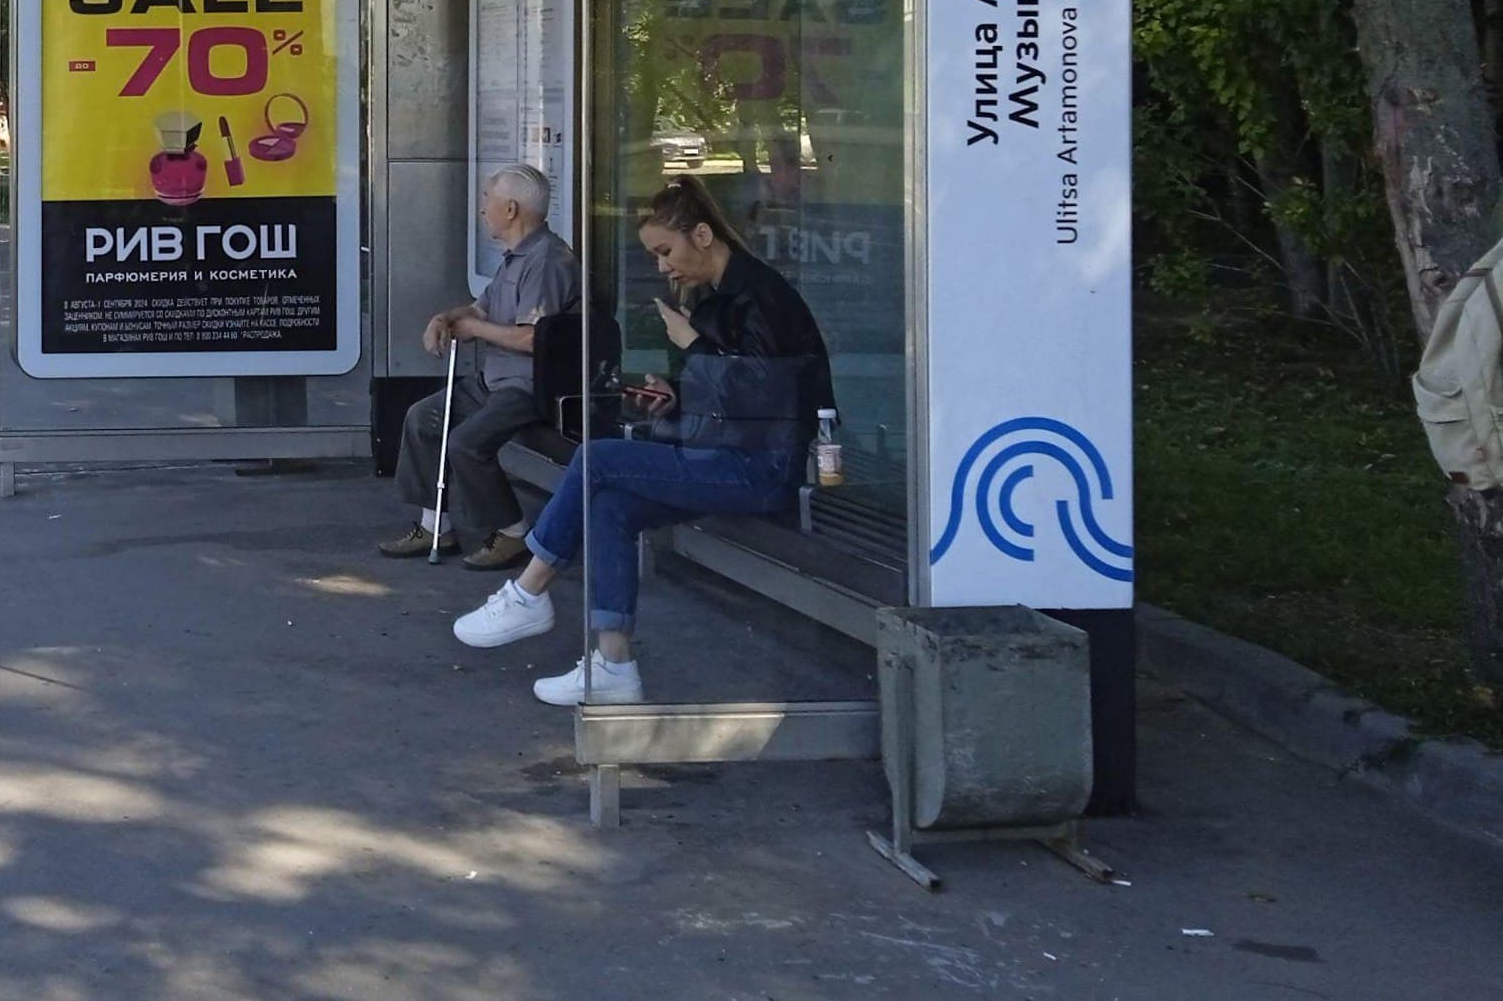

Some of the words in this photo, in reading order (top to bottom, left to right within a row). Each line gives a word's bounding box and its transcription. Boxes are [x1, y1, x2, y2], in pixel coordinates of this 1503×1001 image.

[967, 22, 1003, 146] Улица
[1057, 7, 1078, 165] Artamonova
[85, 226, 183, 263] РИВ
[196, 224, 297, 261] ГОШ
[1055, 174, 1078, 245] Ulitsa
[85, 271, 188, 283] ПАРФЮМЕРИЯ
[194, 271, 203, 281] И
[209, 269, 298, 281] КОСМЕТИКА
